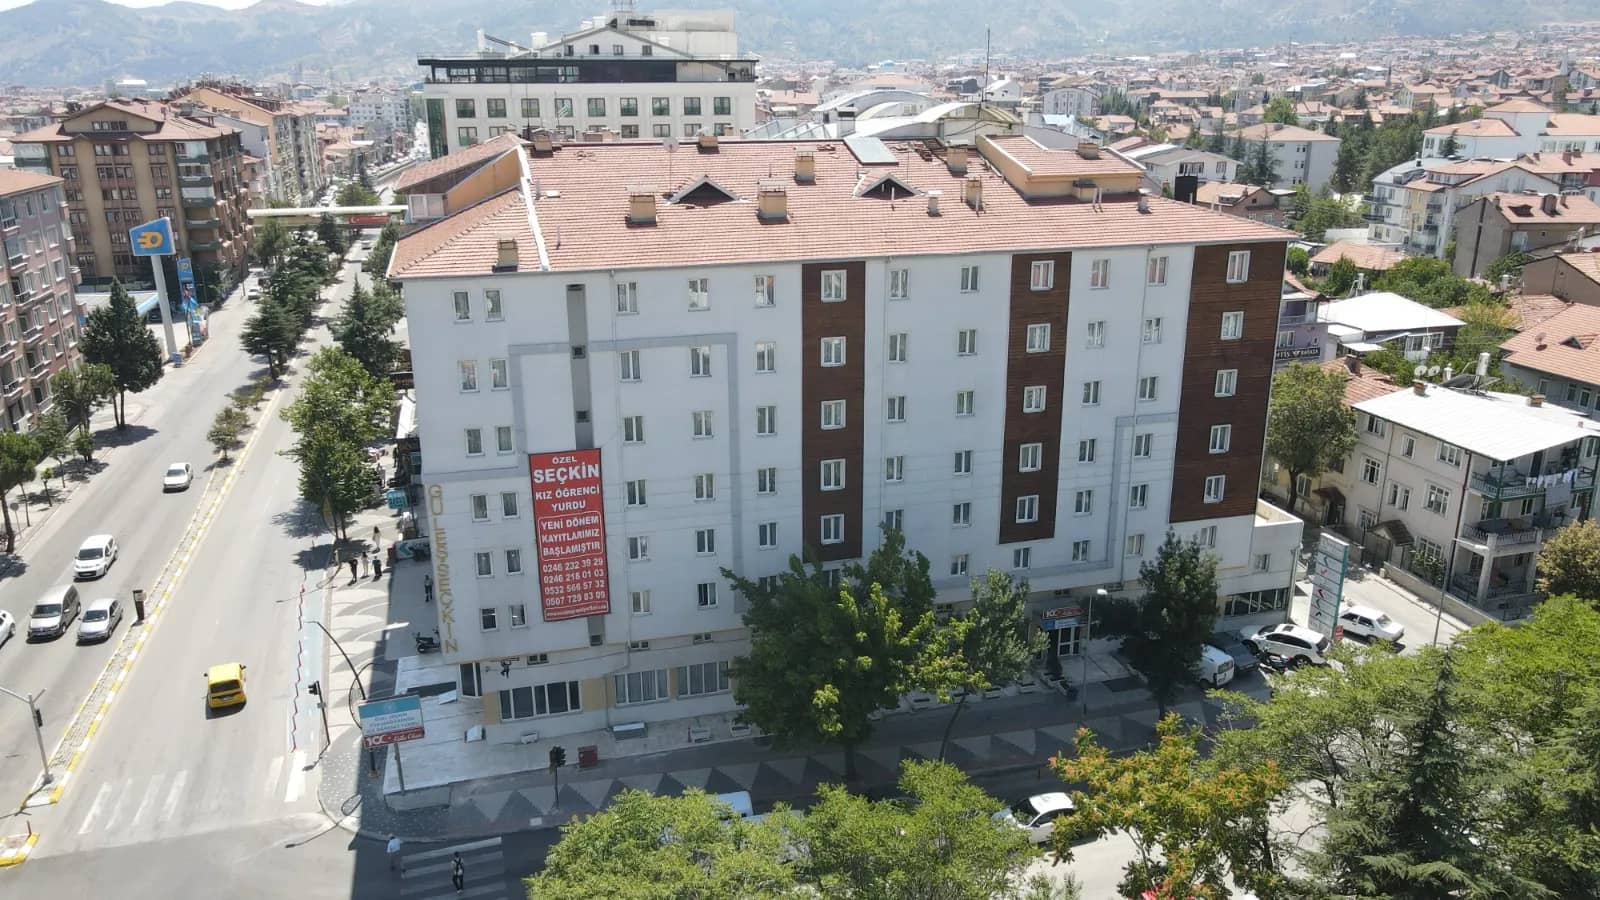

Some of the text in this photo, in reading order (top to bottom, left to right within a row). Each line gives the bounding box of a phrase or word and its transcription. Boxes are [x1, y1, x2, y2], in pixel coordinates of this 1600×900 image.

[552, 456, 577, 464] ÖZEL
[533, 462, 599, 484] SEÇKİN
[535, 484, 600, 500] KIZ ÖĞRENCİ
[552, 500, 586, 512] YURDU
[541, 515, 599, 530] YENİ DÖNEM
[541, 528, 600, 543] KAYITLARIMIZ
[543, 541, 600, 557] BAŞLAMIŞTIR
